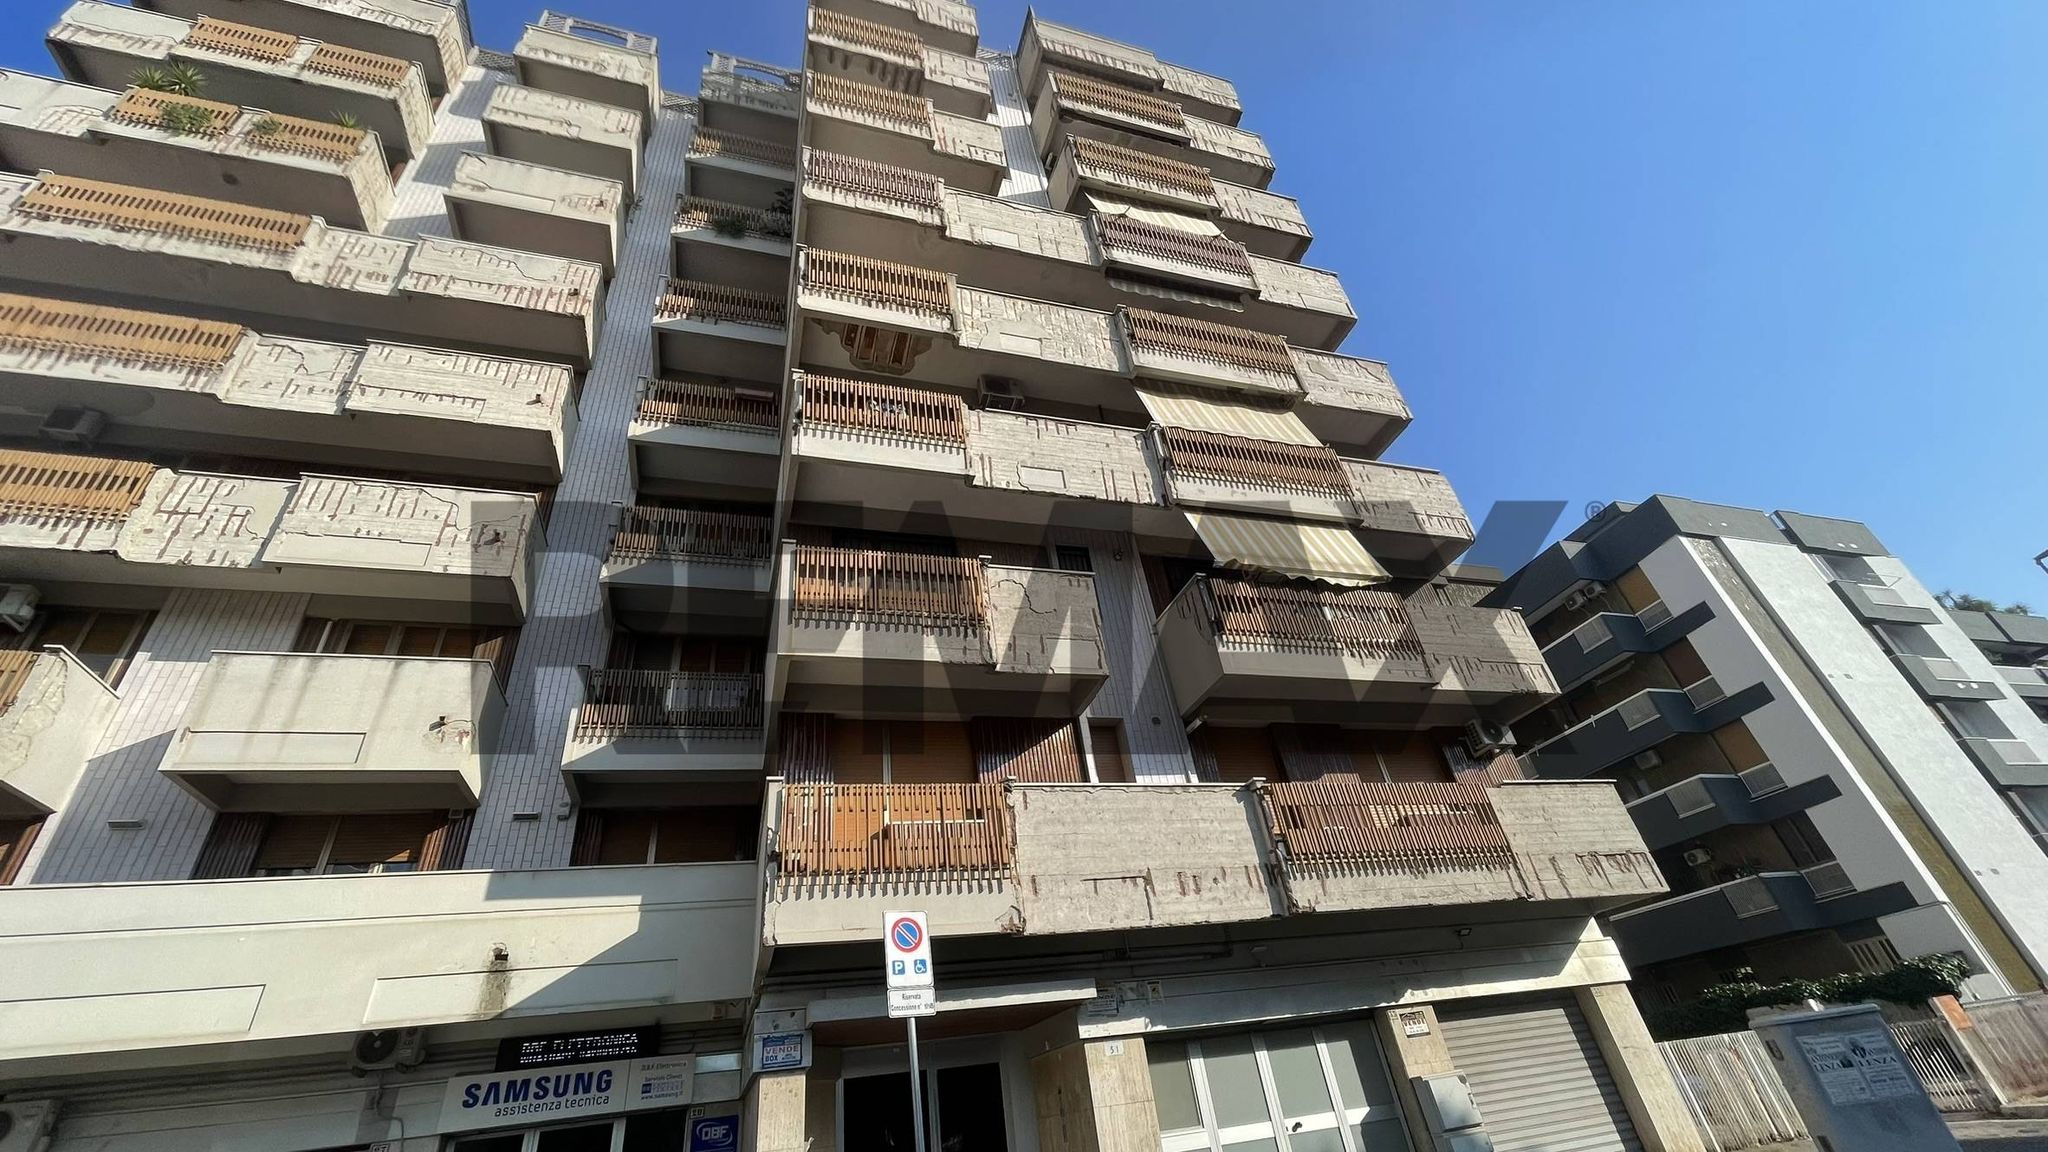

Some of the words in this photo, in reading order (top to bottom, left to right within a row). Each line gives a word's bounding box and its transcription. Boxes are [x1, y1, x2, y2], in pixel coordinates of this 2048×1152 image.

[765, 1045, 799, 1054] VENDE
[462, 1069, 613, 1108] SAMSUNG
[494, 1101, 561, 1117] assistenza
[564, 1095, 609, 1109] tecnica
